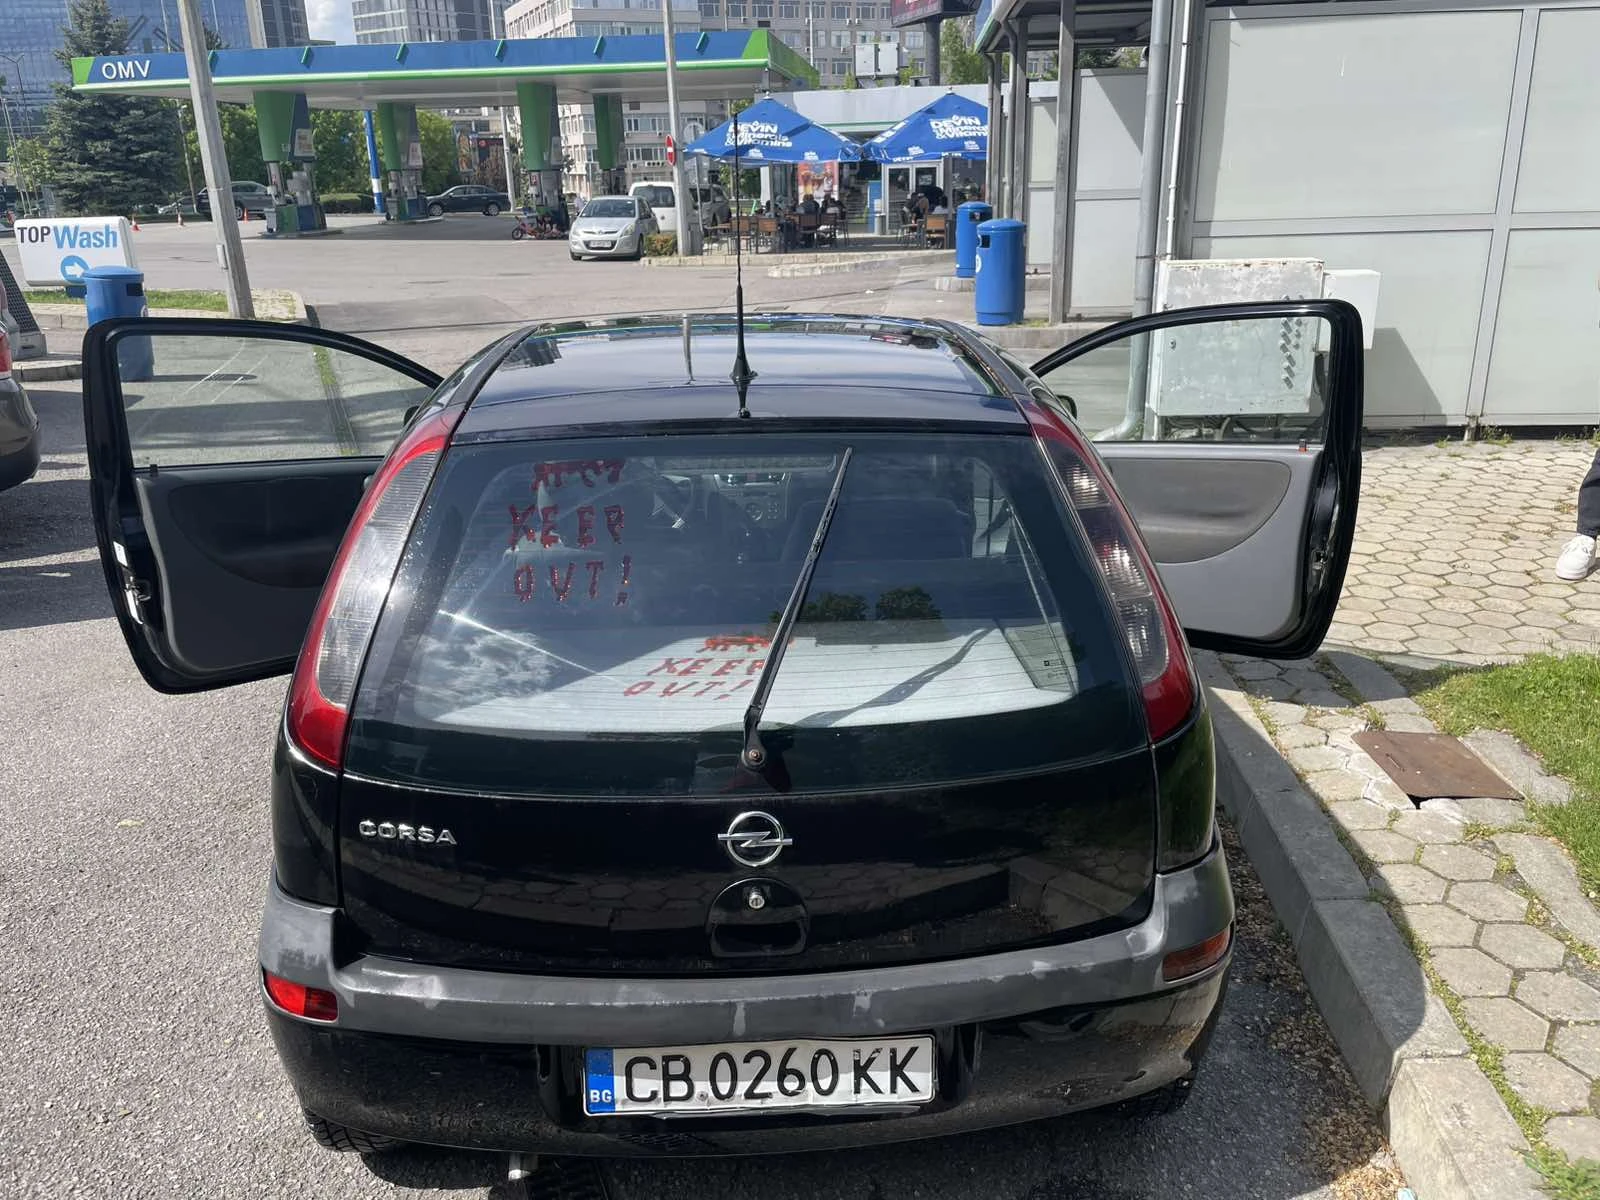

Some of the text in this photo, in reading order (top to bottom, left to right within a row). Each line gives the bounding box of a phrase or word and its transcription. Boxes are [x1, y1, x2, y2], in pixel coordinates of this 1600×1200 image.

[102, 60, 150, 79] OMV
[728, 120, 778, 133] DEVIN
[929, 115, 981, 128] DEVIN
[17, 224, 118, 248] TOP Wash
[508, 504, 625, 551] KEEP
[358, 819, 457, 846] CORSA
[625, 1046, 920, 1103] CB 0260 KK
[590, 1090, 612, 1103] BG
